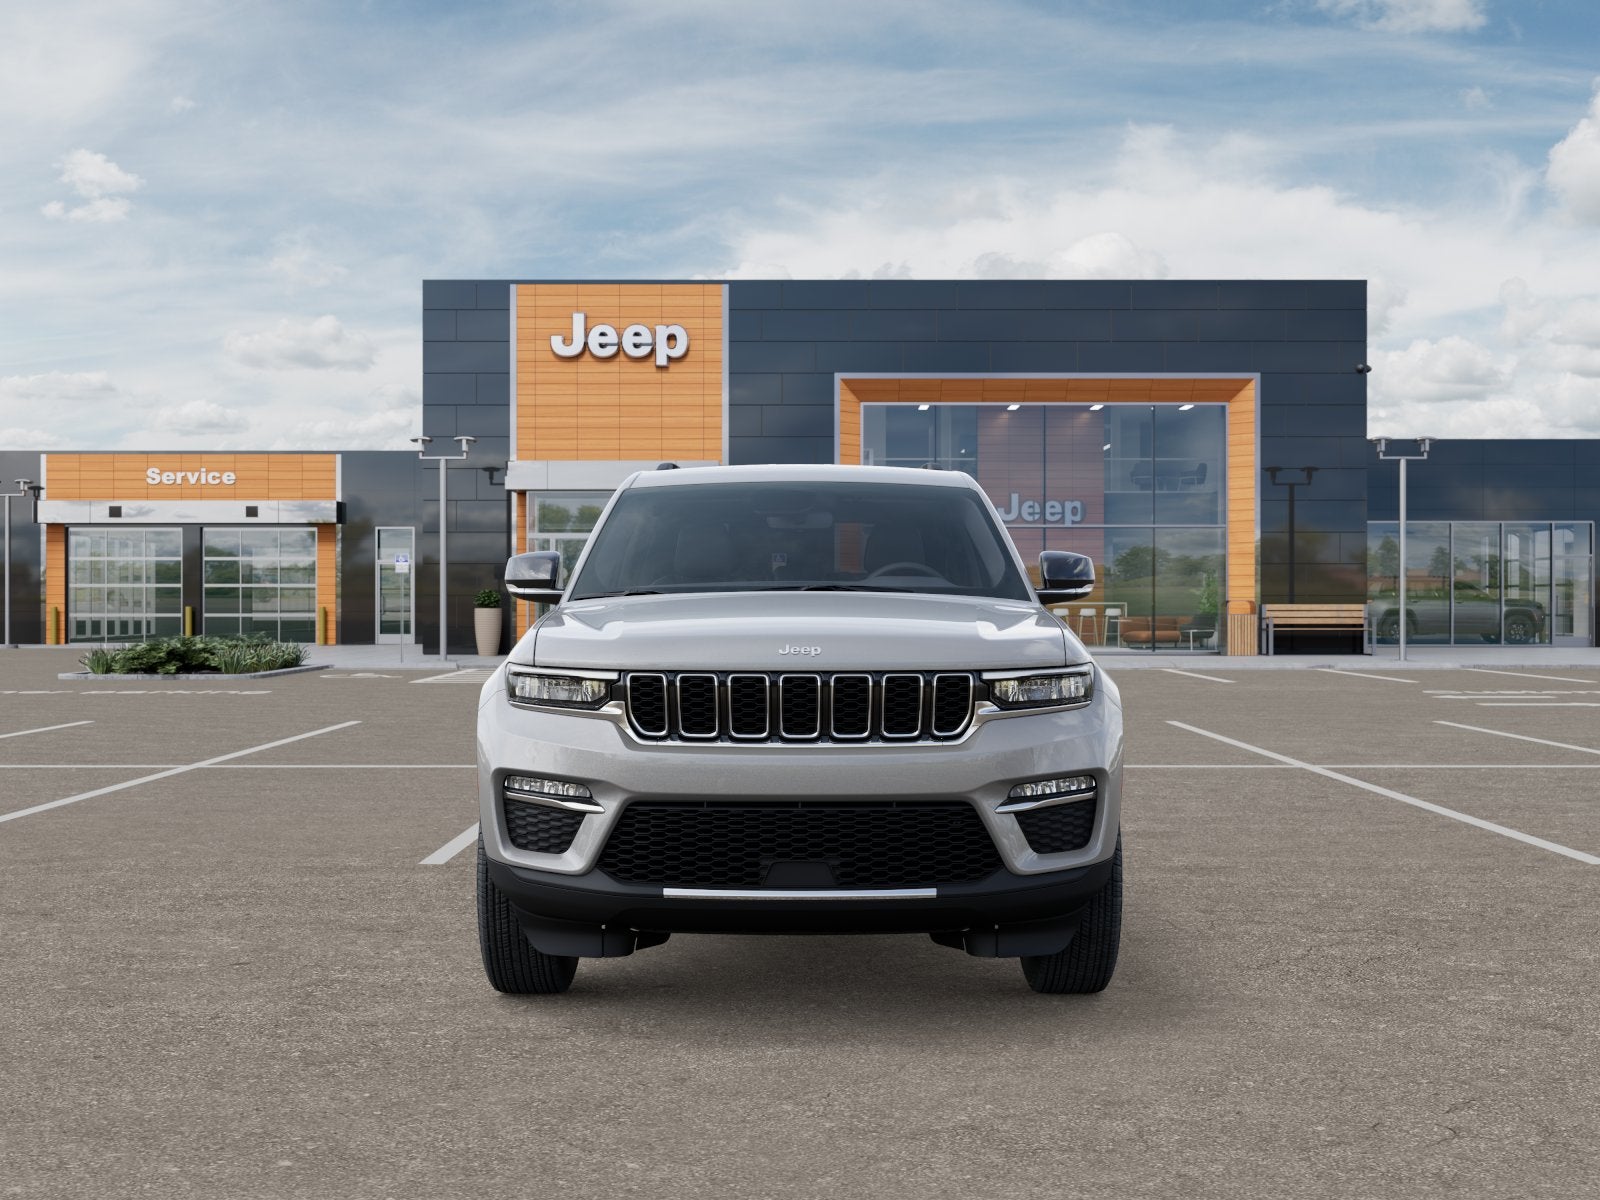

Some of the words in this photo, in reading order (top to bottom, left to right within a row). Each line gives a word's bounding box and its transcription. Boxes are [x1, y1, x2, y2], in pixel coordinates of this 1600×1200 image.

[550, 312, 689, 368] Jeep
[146, 467, 236, 485] Service
[998, 493, 1083, 526] Jeep
[778, 643, 822, 657] Jeep
